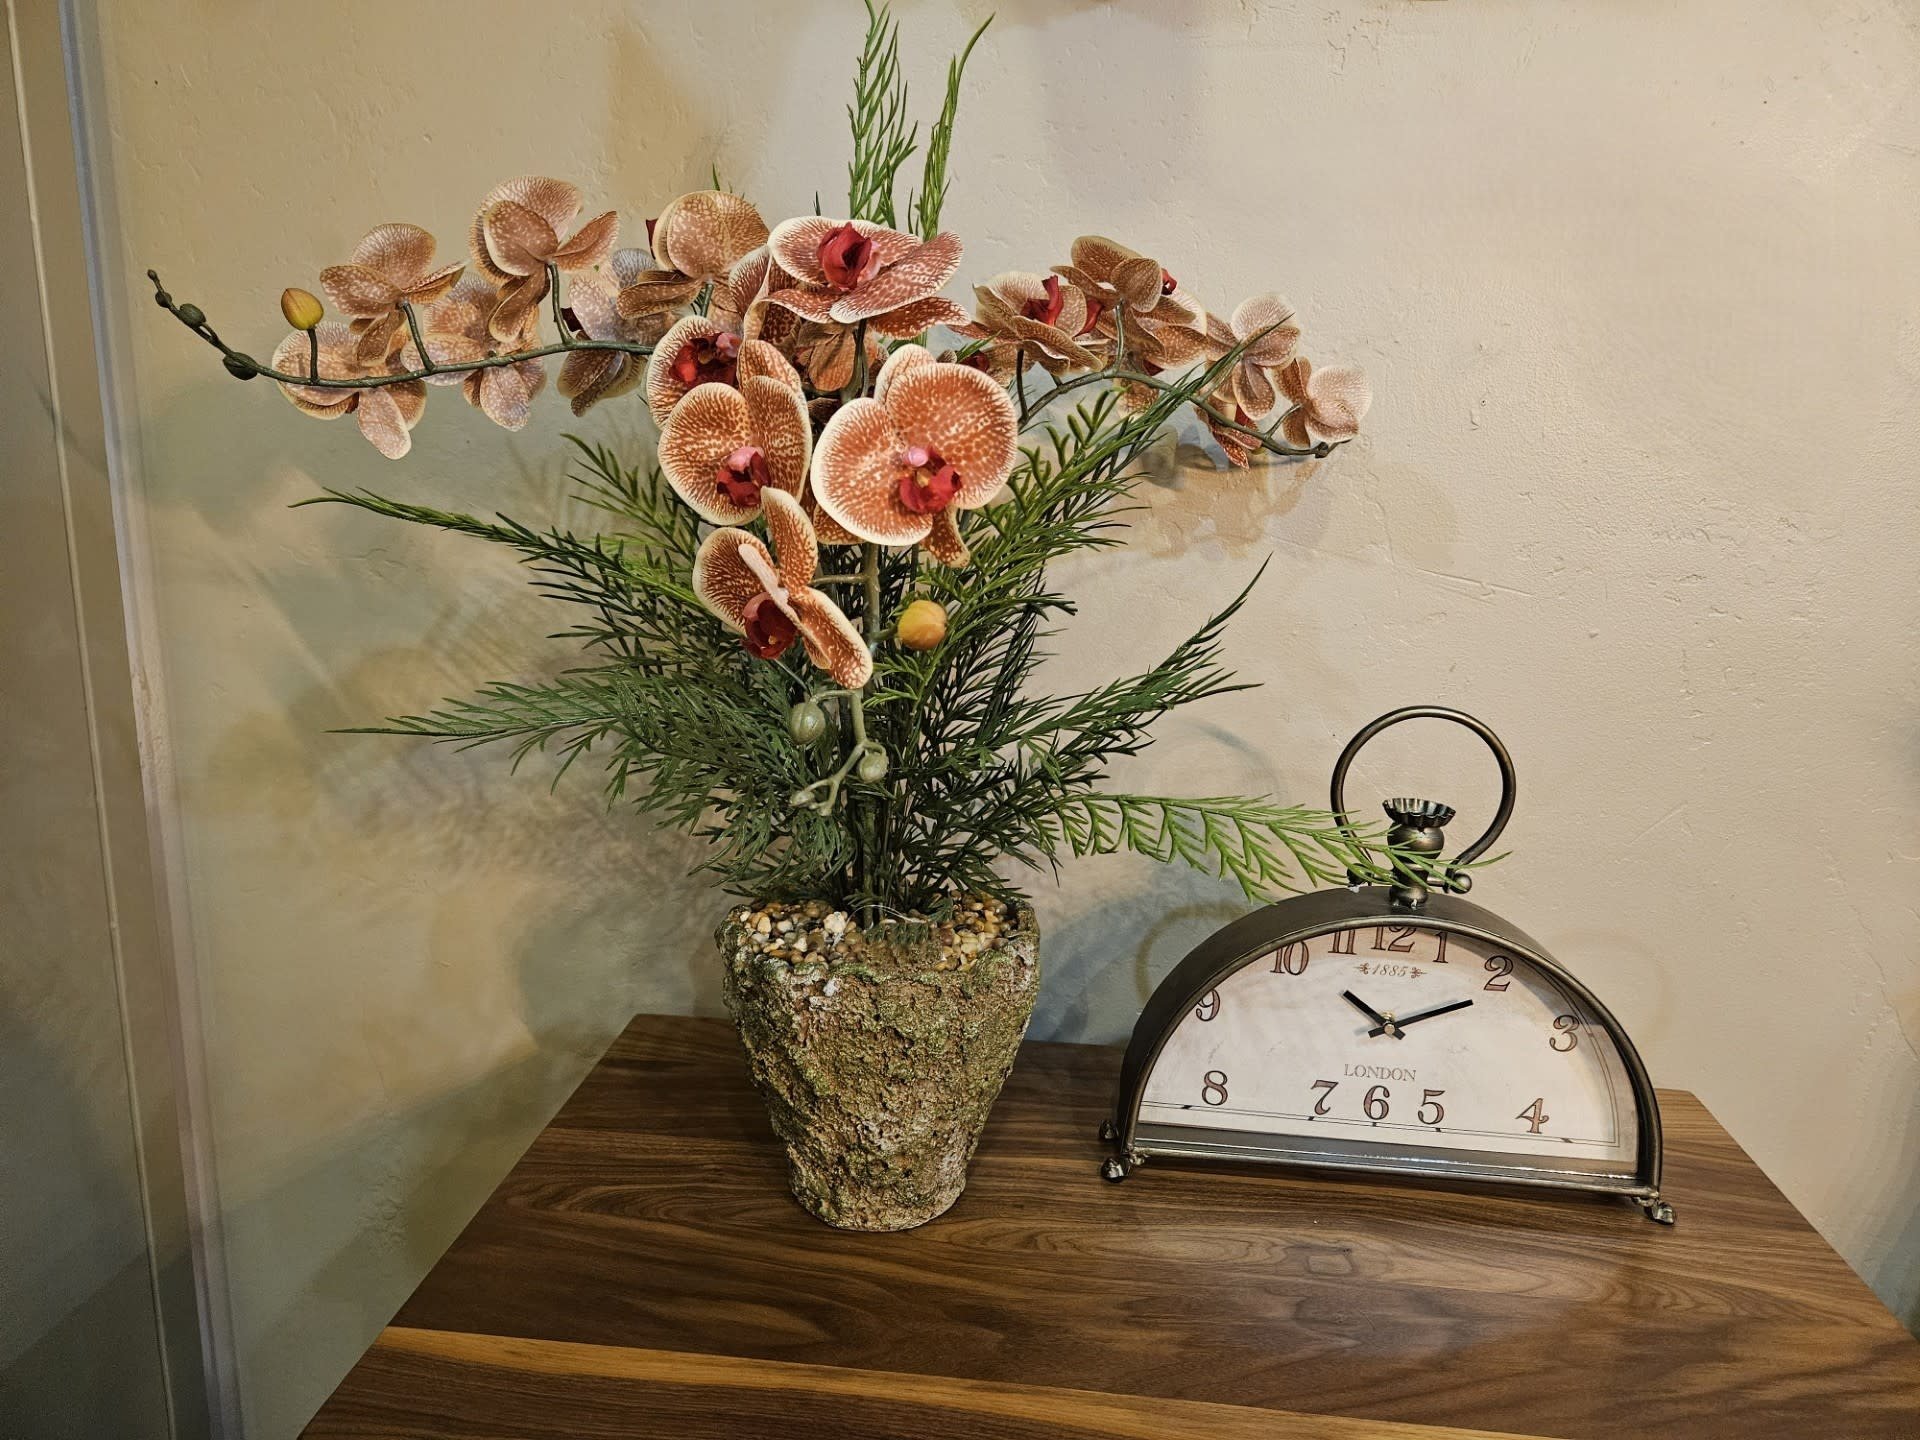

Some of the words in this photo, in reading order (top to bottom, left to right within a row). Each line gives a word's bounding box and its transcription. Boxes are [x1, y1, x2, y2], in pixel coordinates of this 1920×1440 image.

[1371, 926, 1416, 952] 12
[1433, 931, 1448, 963] 1
[1269, 940, 1309, 976] 10
[1373, 963, 1408, 978] 1885
[1483, 955, 1514, 992] 2
[1195, 988, 1221, 1022] 9
[1549, 1014, 1580, 1052] 3
[1201, 1070, 1229, 1106] 8
[1344, 1063, 1417, 1082] LONDON
[1310, 1079, 1339, 1115] 7
[1363, 1085, 1390, 1120] 6
[1417, 1089, 1445, 1125] 5
[1515, 1098, 1549, 1134] 4
